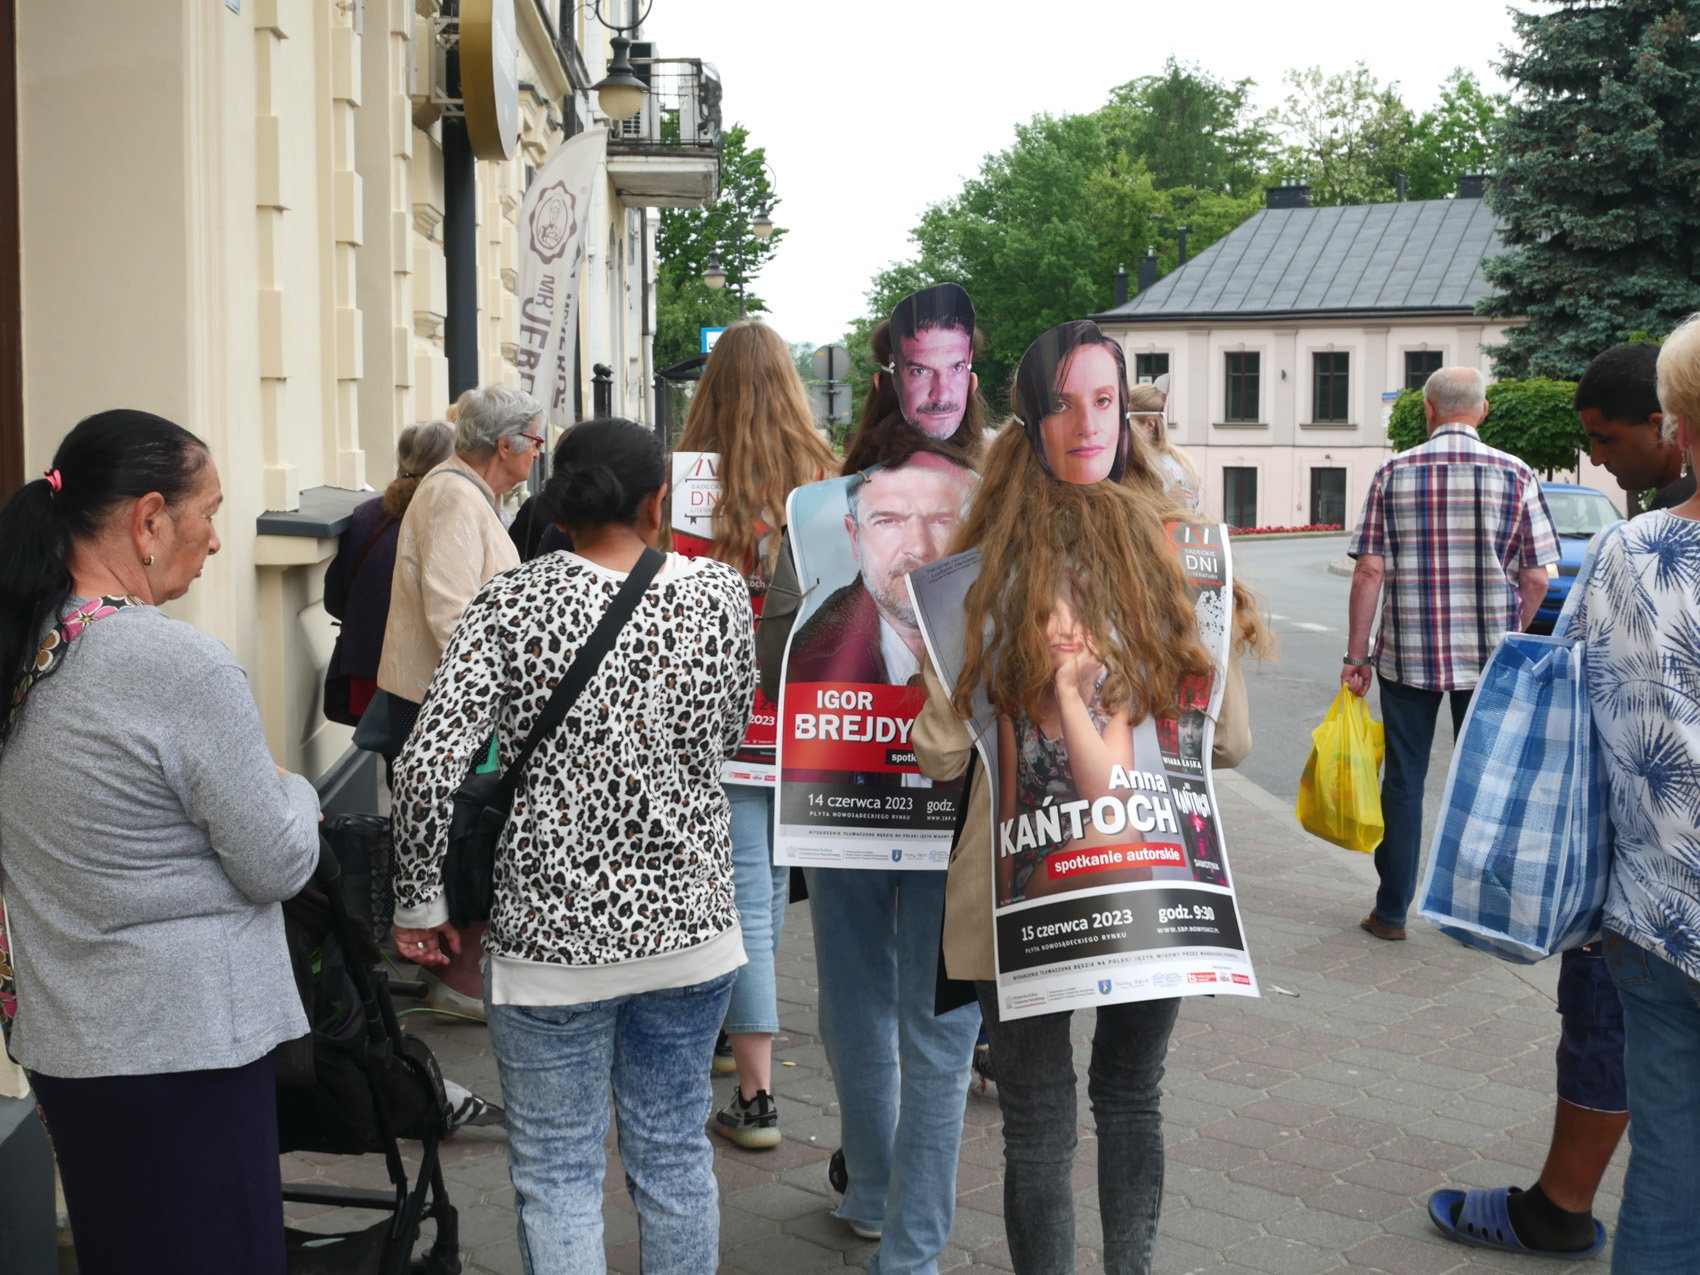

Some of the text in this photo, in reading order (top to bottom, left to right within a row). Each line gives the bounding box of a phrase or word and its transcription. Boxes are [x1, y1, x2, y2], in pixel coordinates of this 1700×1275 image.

[691, 491, 721, 506] DN
[1186, 554, 1218, 573] DNI
[817, 690, 873, 710] IGOR
[750, 714, 776, 726] 2023
[795, 714, 914, 744] BREJDY
[891, 752, 917, 764] spotk
[1109, 764, 1167, 794] Anna
[808, 793, 955, 814] 14 czerwca 2023 godz.
[1000, 795, 1178, 858] KAŃTOCH
[1055, 847, 1180, 873] spotkanie autorskie
[1021, 904, 1215, 941] 15 czerwca 2023 godz. 9:30
[1102, 932, 1127, 941] RYNKU
